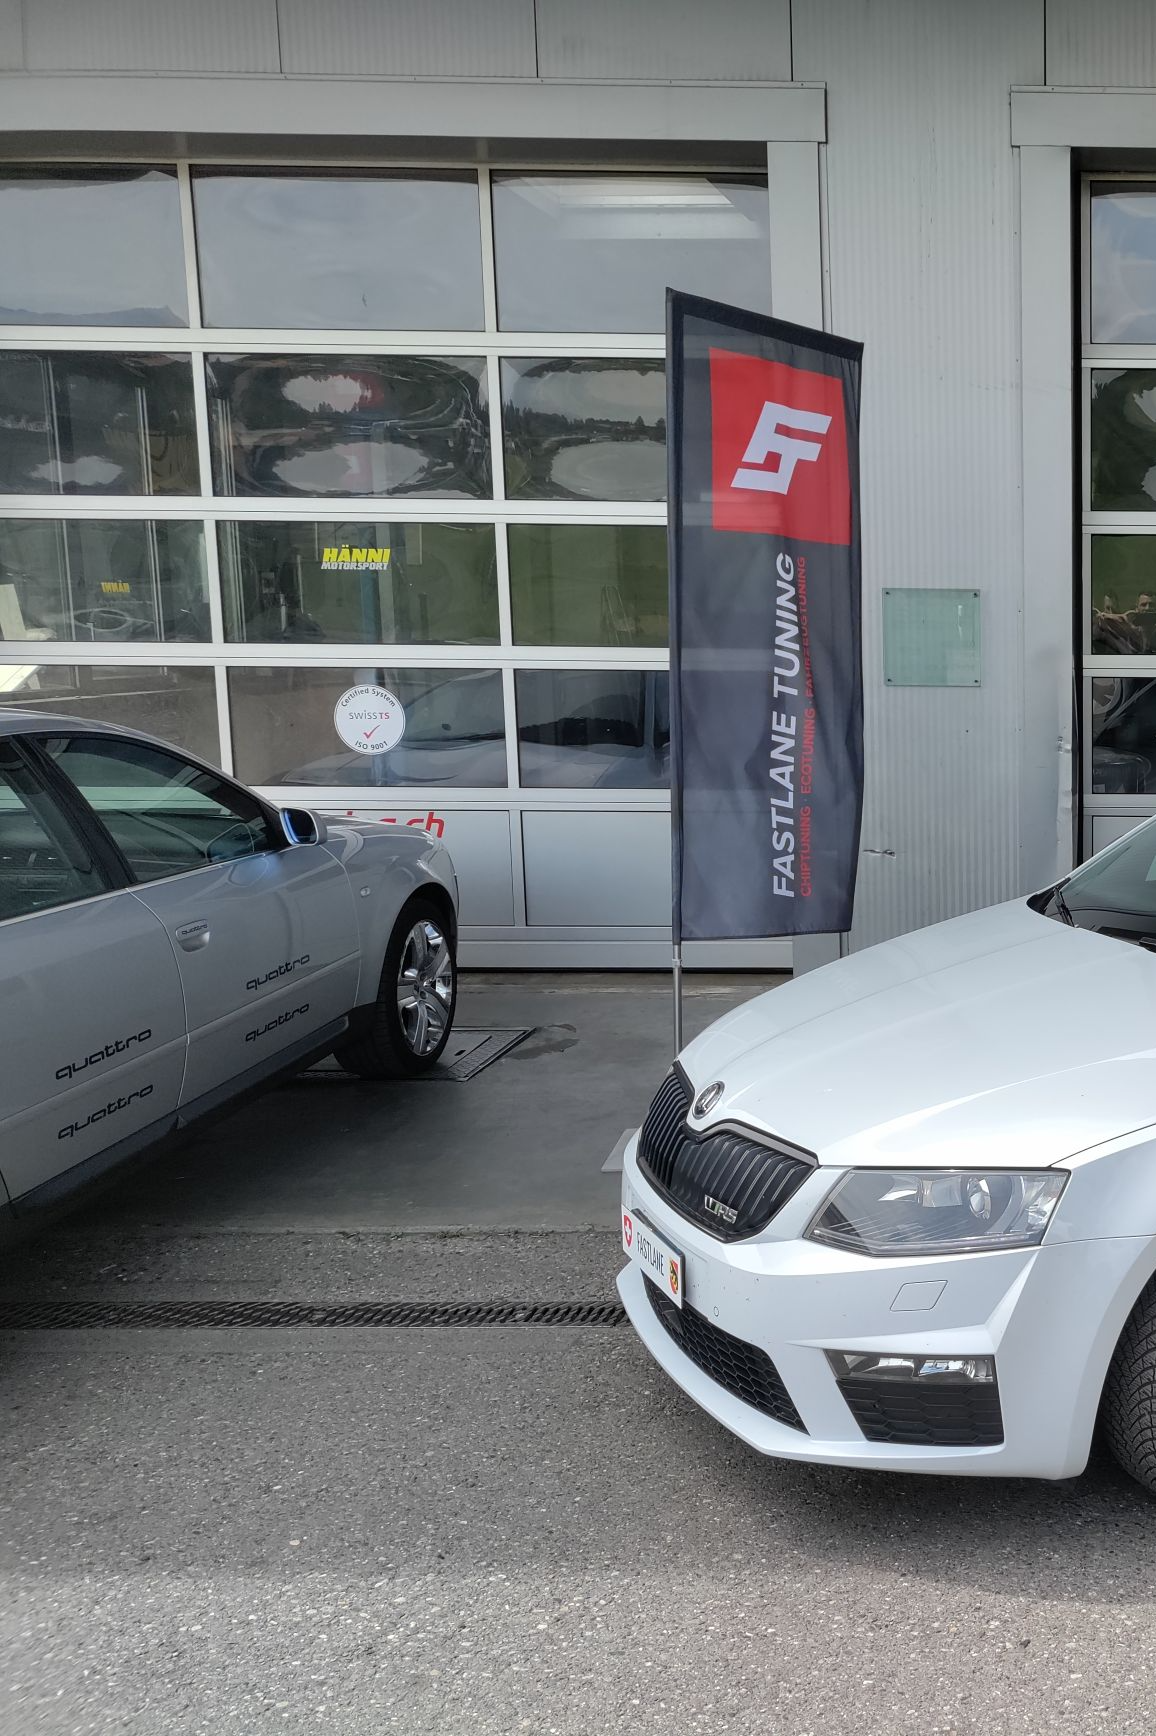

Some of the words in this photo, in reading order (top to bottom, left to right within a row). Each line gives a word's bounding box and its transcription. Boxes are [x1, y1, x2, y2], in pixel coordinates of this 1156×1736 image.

[321, 562, 389, 570] MOTORSPORT
[323, 544, 391, 562] HÄNNI
[773, 552, 800, 698] TUNING
[341, 688, 369, 707] Certified
[372, 688, 396, 707] System
[355, 740, 368, 750] ISO
[371, 741, 388, 751] 9001
[801, 708, 816, 794] ECOTUNING
[769, 711, 796, 897] FASTLANE
[800, 806, 812, 896] CHIPTUNING
[247, 954, 310, 990] quattro
[246, 1004, 310, 1042] quattro
[56, 1029, 152, 1080] quattro
[58, 1084, 153, 1140] quattro
[636, 1232, 665, 1277] FASTLANE
